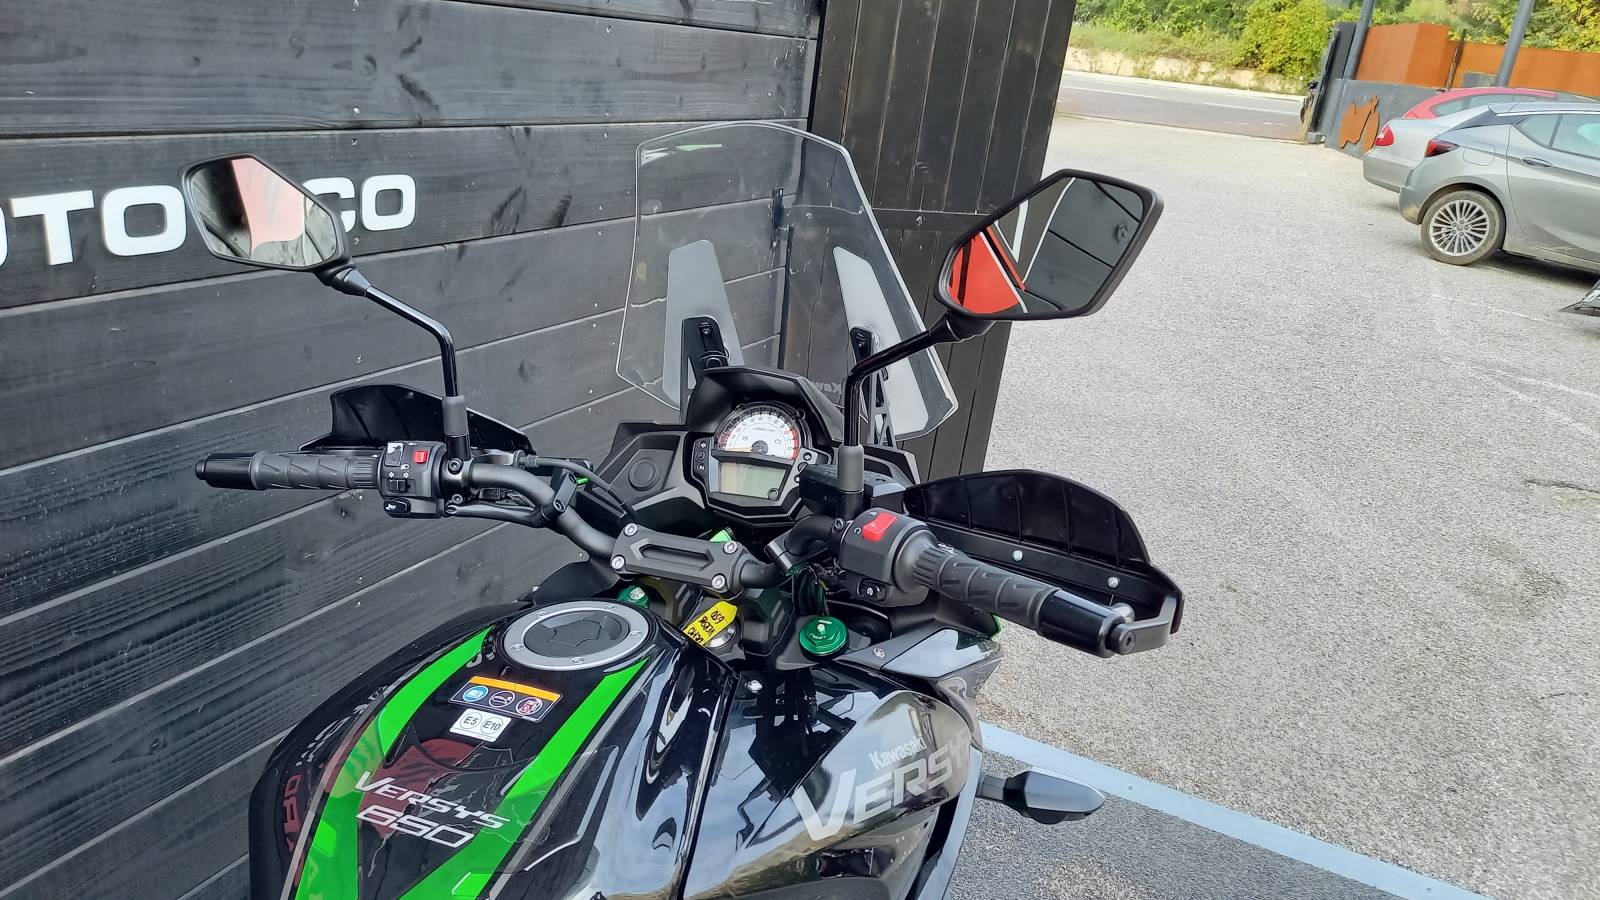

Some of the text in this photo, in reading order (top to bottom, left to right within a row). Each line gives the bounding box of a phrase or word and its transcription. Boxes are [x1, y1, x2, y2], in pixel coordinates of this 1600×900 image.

[0, 184, 187, 267] TO
[463, 716, 502, 731] E5 E10
[355, 771, 511, 829] VERSYS
[356, 804, 475, 848] 650
